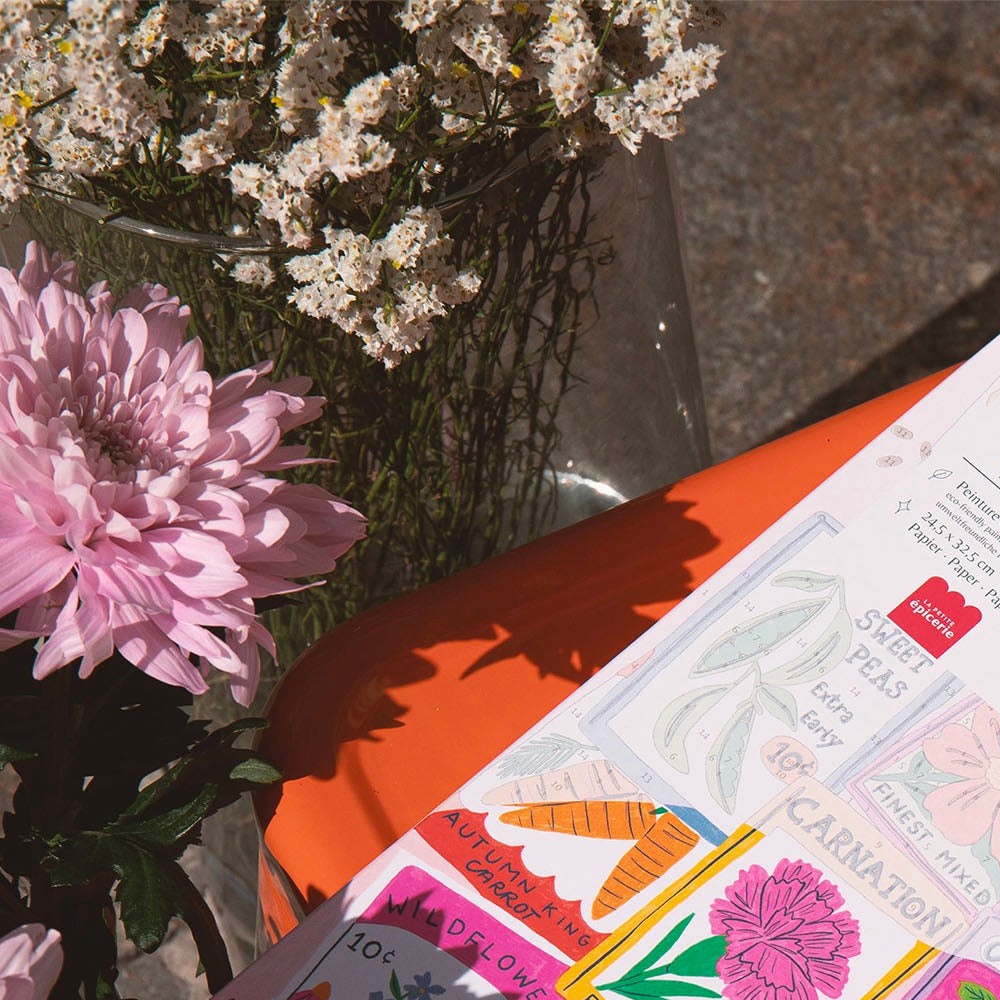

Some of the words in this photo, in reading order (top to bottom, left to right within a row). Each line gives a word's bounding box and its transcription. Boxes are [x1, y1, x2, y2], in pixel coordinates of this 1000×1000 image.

[935, 501, 998, 555] umweltfreundliche
[945, 492, 987, 531] eco-friendly
[956, 481, 1000, 522] Peinture
[908, 522, 943, 555] Papier
[948, 557, 980, 587] Paper
[921, 511, 944, 536] 24,5
[952, 538, 977, 564] 32,5
[977, 558, 995, 577] cm
[909, 599, 954, 639] épicerie
[923, 598, 933, 609] LA
[931, 605, 956, 627] PETITE
[855, 609, 934, 674] SWEET
[845, 644, 907, 699] PEAS
[800, 709, 844, 748] Early
[810, 681, 854, 724] Extra
[785, 797, 951, 939] CARNATION
[872, 782, 934, 843] FINEST
[934, 849, 993, 906] MIXED
[442, 811, 536, 894] AUTUMN
[543, 903, 591, 947] KING
[466, 859, 541, 921] CARROT
[346, 932, 396, 964] 10¢
